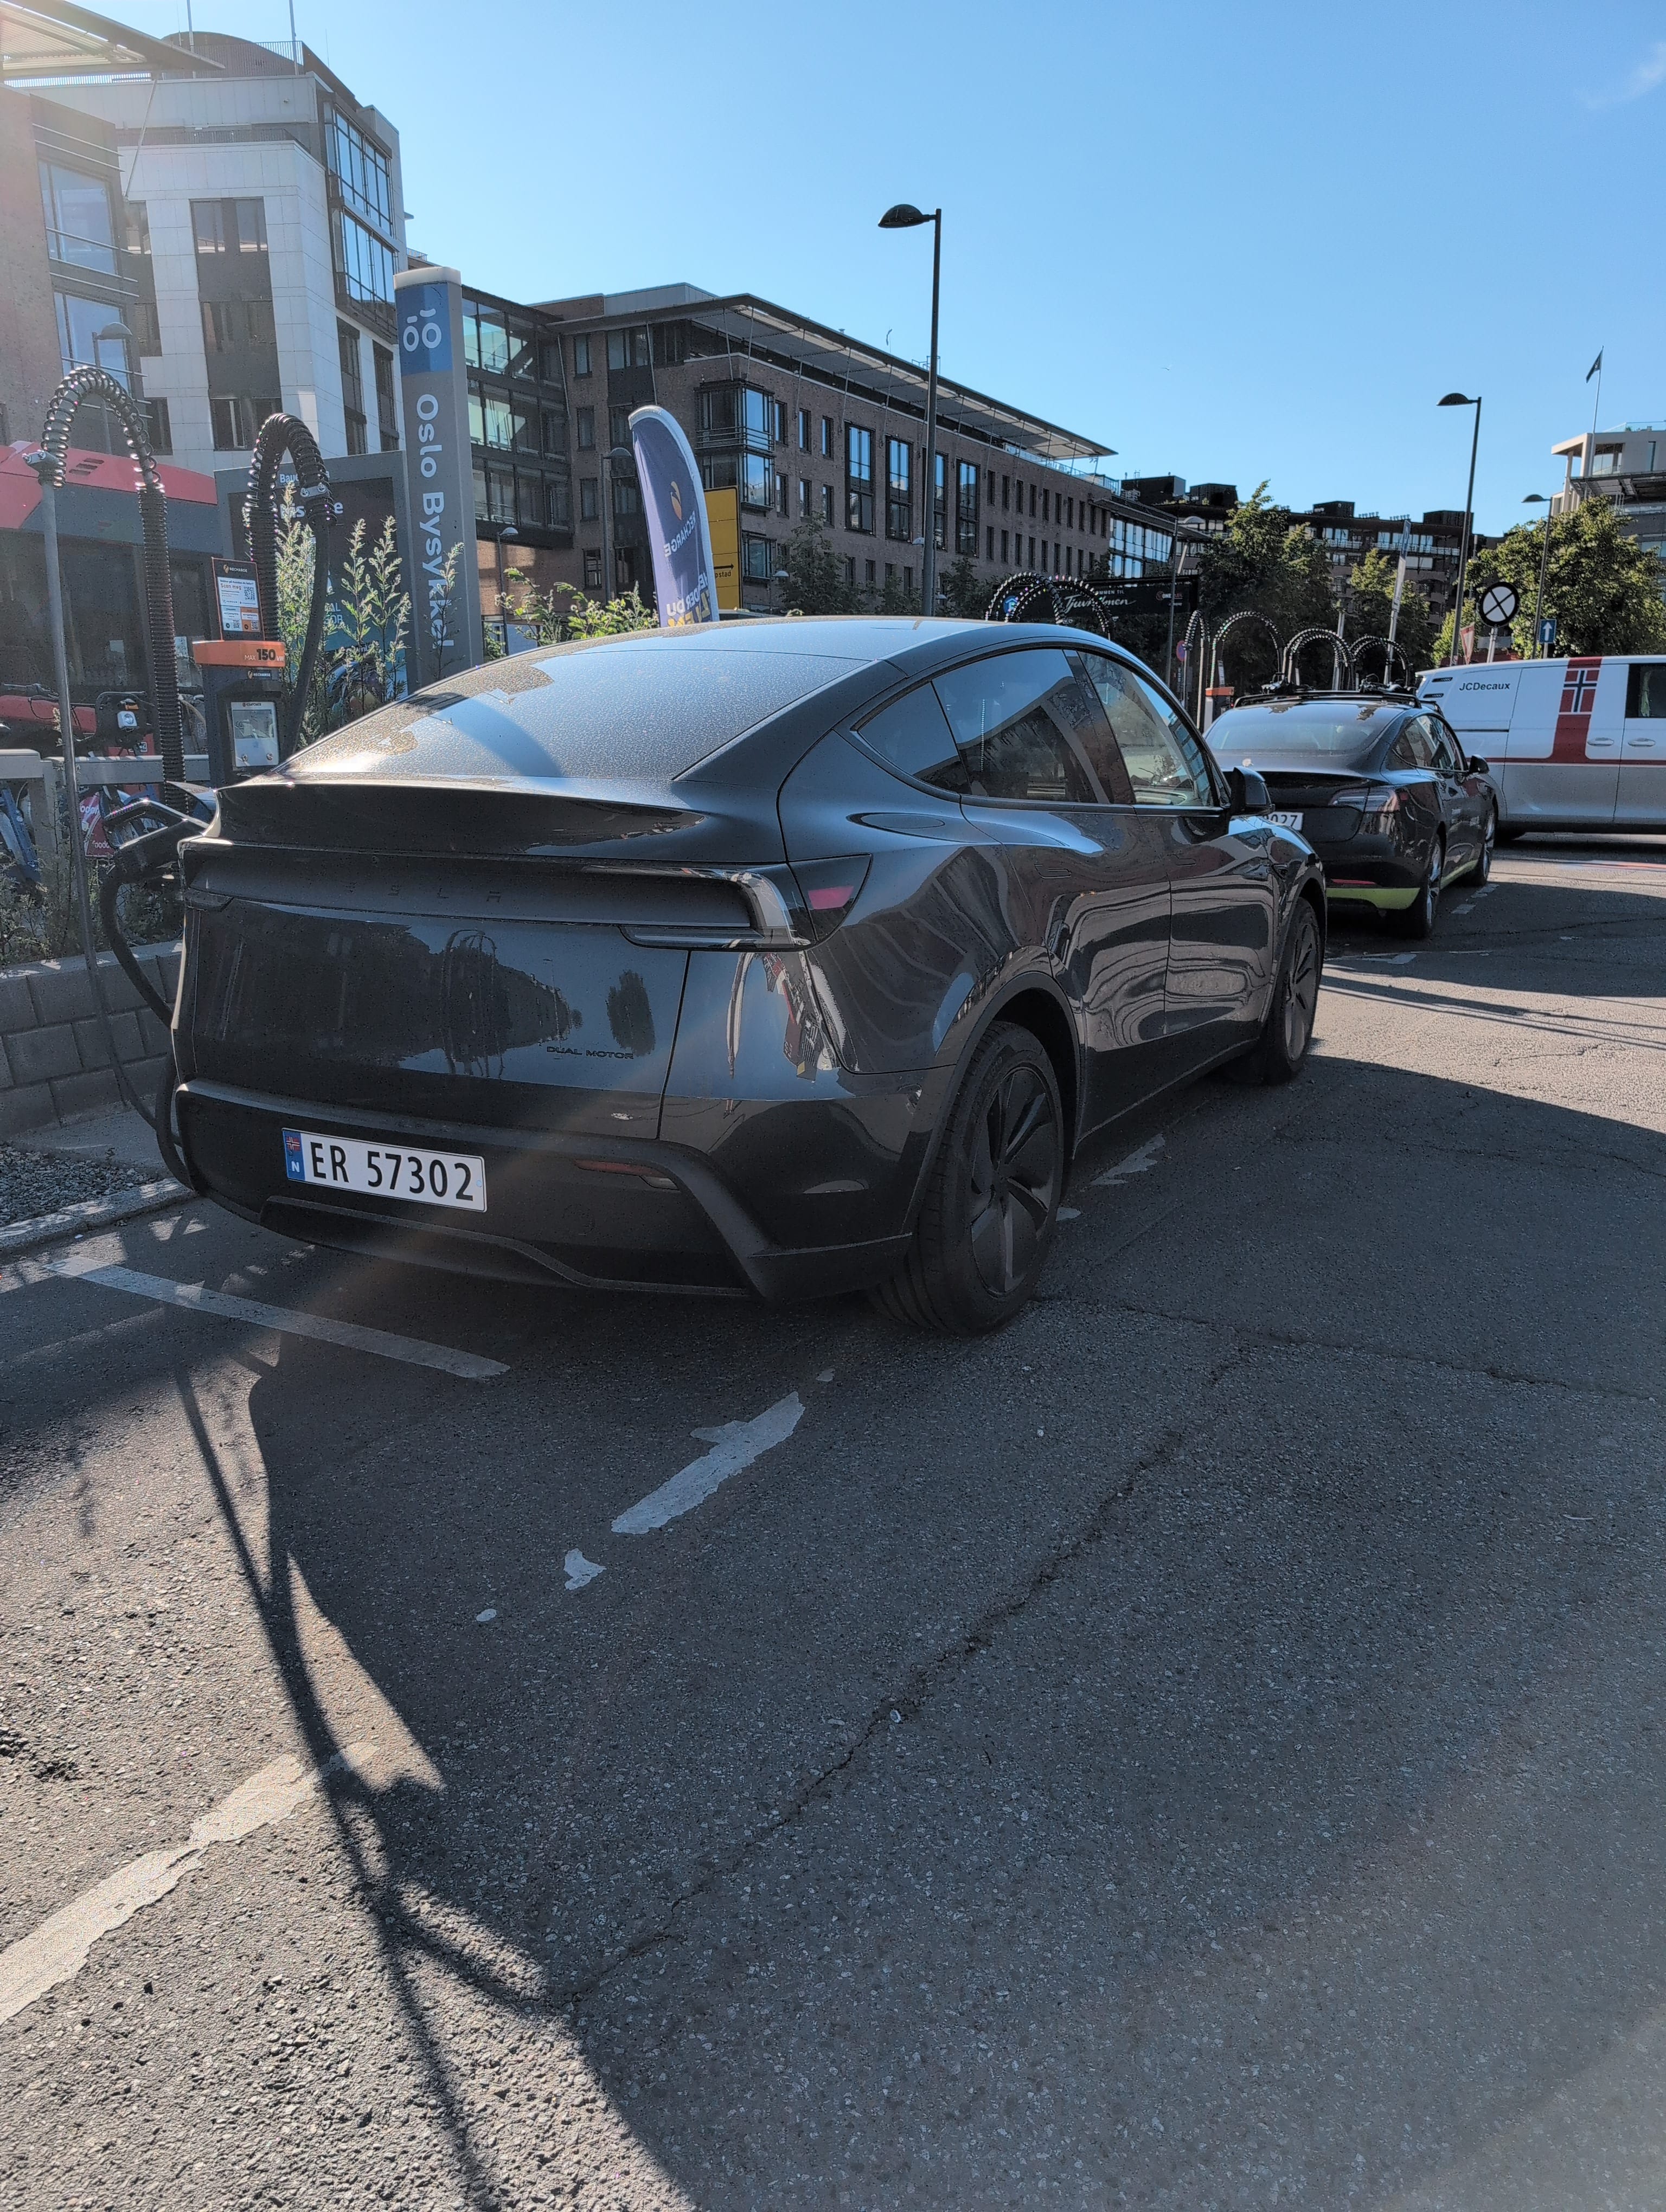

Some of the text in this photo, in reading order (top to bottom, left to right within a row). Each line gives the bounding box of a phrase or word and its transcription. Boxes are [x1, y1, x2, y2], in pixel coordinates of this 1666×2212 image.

[416, 394, 454, 647] Oslo Bysykkel
[257, 648, 275, 661] 150
[1459, 682, 1510, 691] JCDecaux
[1263, 814, 1298, 827] 027
[546, 1046, 634, 1059] DUAL MOTOR
[291, 1161, 300, 1173] N
[310, 1141, 473, 1201] ER 57302
